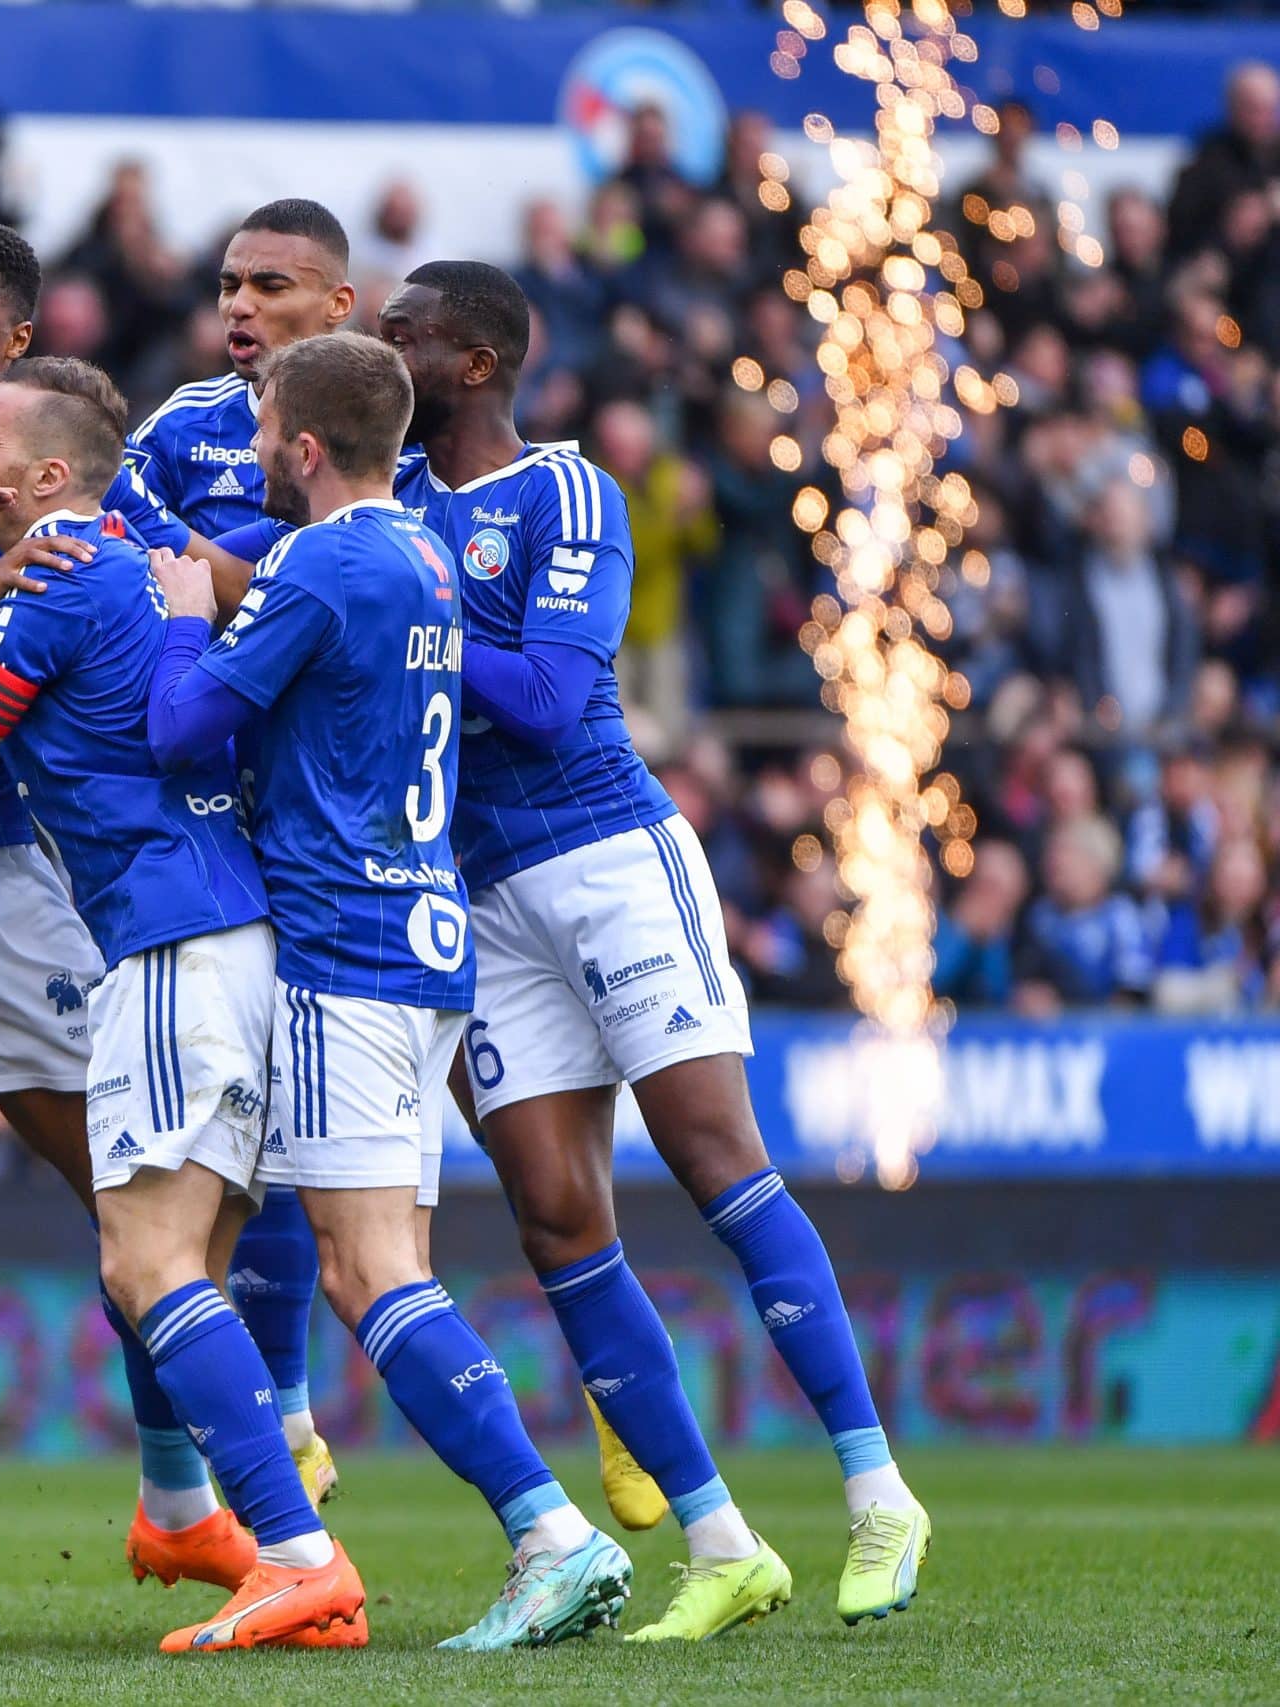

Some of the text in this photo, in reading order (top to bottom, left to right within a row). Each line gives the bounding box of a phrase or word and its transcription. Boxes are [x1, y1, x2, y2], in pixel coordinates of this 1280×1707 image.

[208, 485, 245, 496] adidas
[405, 692, 452, 843] 3
[606, 952, 675, 986] SOPREMA
[664, 1020, 702, 1034] adidas
[466, 1020, 505, 1090] 6
[107, 1146, 145, 1159] adidas
